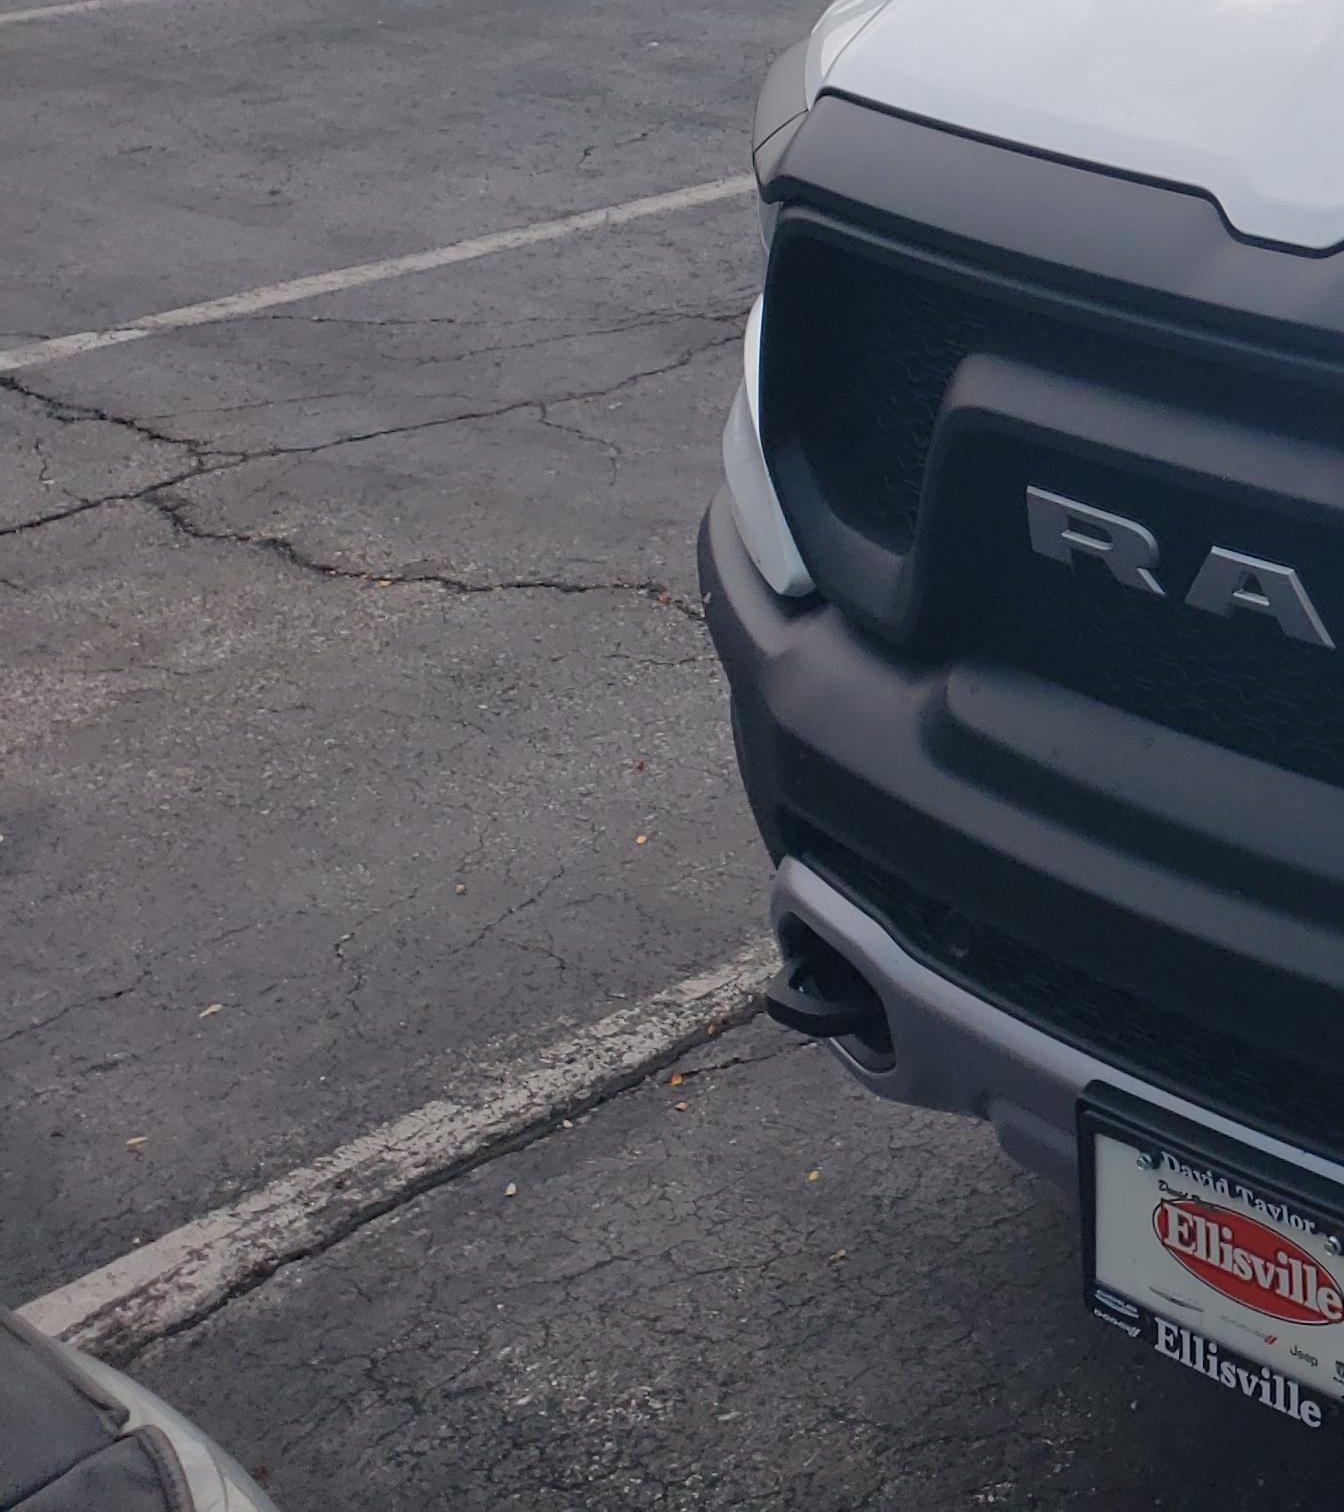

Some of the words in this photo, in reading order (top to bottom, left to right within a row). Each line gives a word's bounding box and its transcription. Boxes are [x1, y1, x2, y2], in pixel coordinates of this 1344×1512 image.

[1160, 1150, 1233, 1199] David
[1235, 1185, 1316, 1236] Taylor
[1162, 1199, 1344, 1321] Ellisville
[1154, 1316, 1322, 1428] Ellisville
